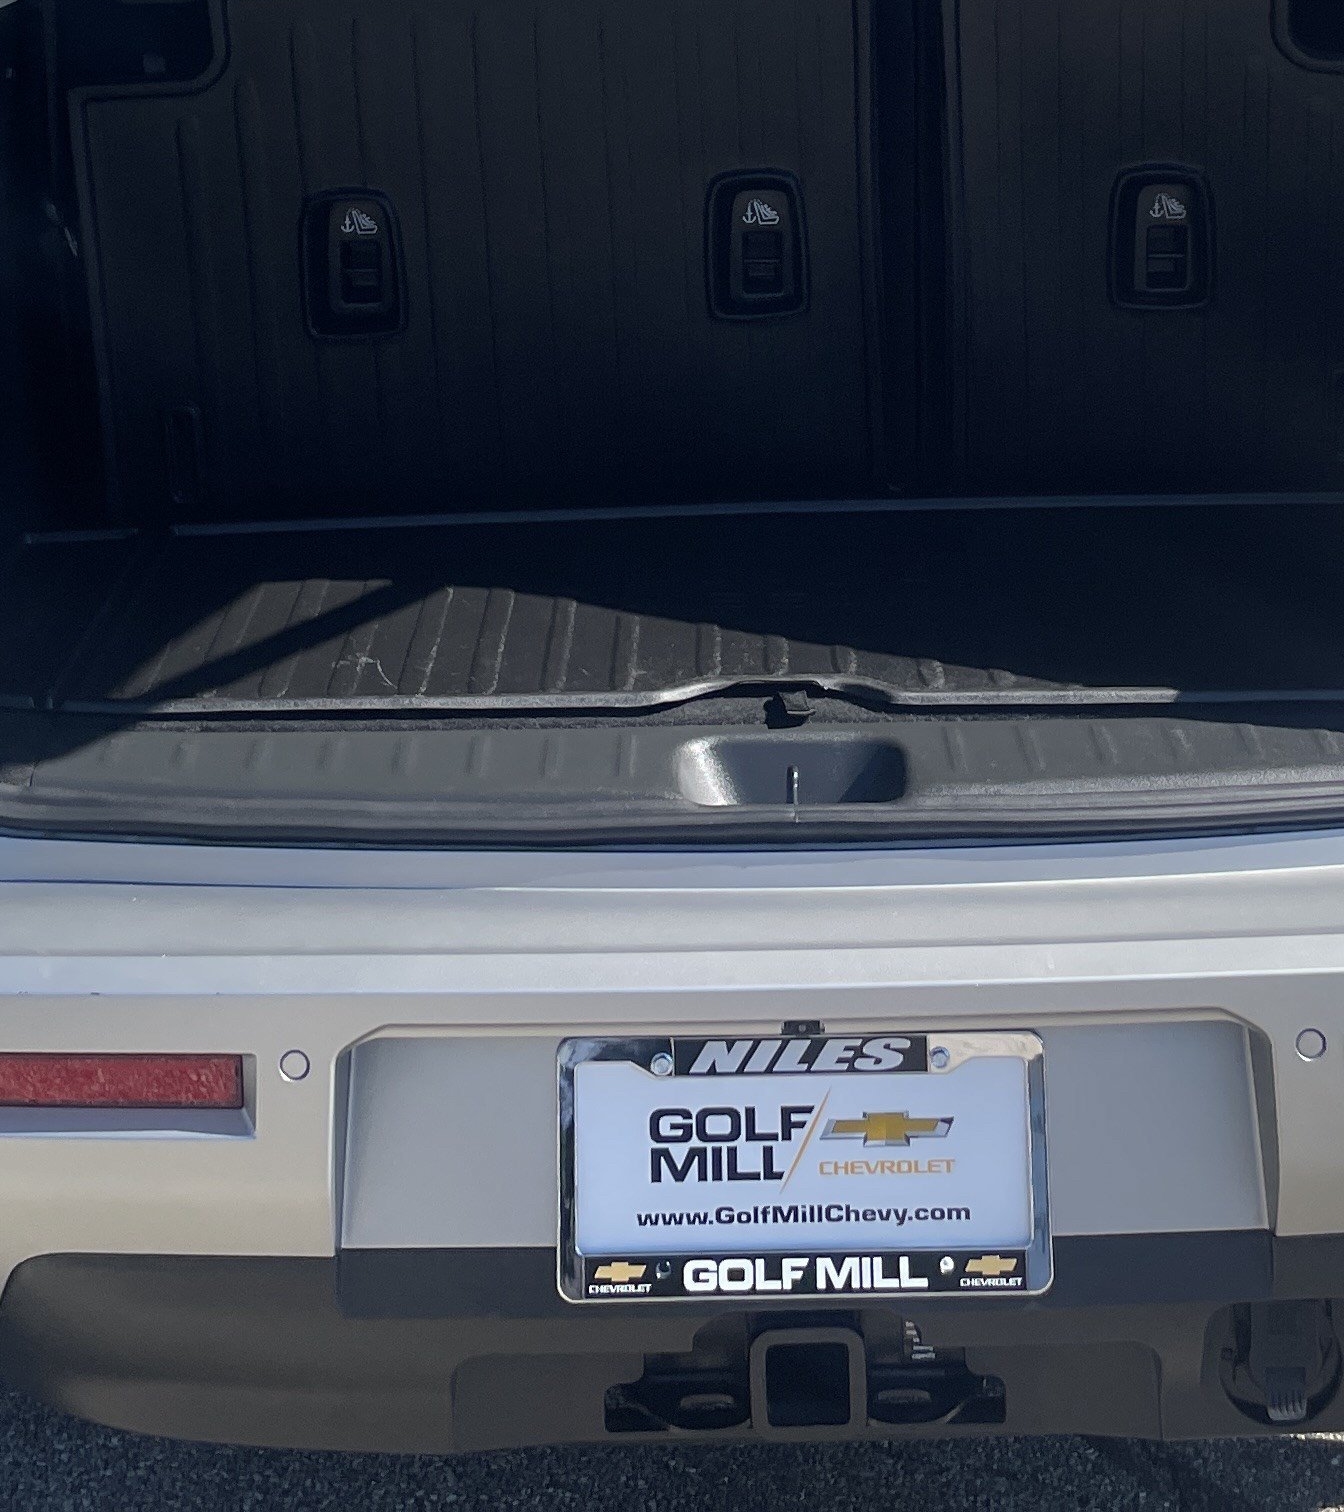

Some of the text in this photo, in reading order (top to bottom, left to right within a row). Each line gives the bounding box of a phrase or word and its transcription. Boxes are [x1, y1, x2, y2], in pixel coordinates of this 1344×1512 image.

[689, 1038, 911, 1074] NILES
[649, 1105, 815, 1143] GOLF
[651, 1145, 786, 1184] MILL
[819, 1158, 955, 1177] CHEVROLET
[636, 1204, 971, 1227] www.GolfMillChevy.com
[684, 1255, 929, 1291] GOLF MILL
[960, 1276, 1023, 1288] CHEVROLET
[588, 1283, 652, 1295] CHEVROLET
